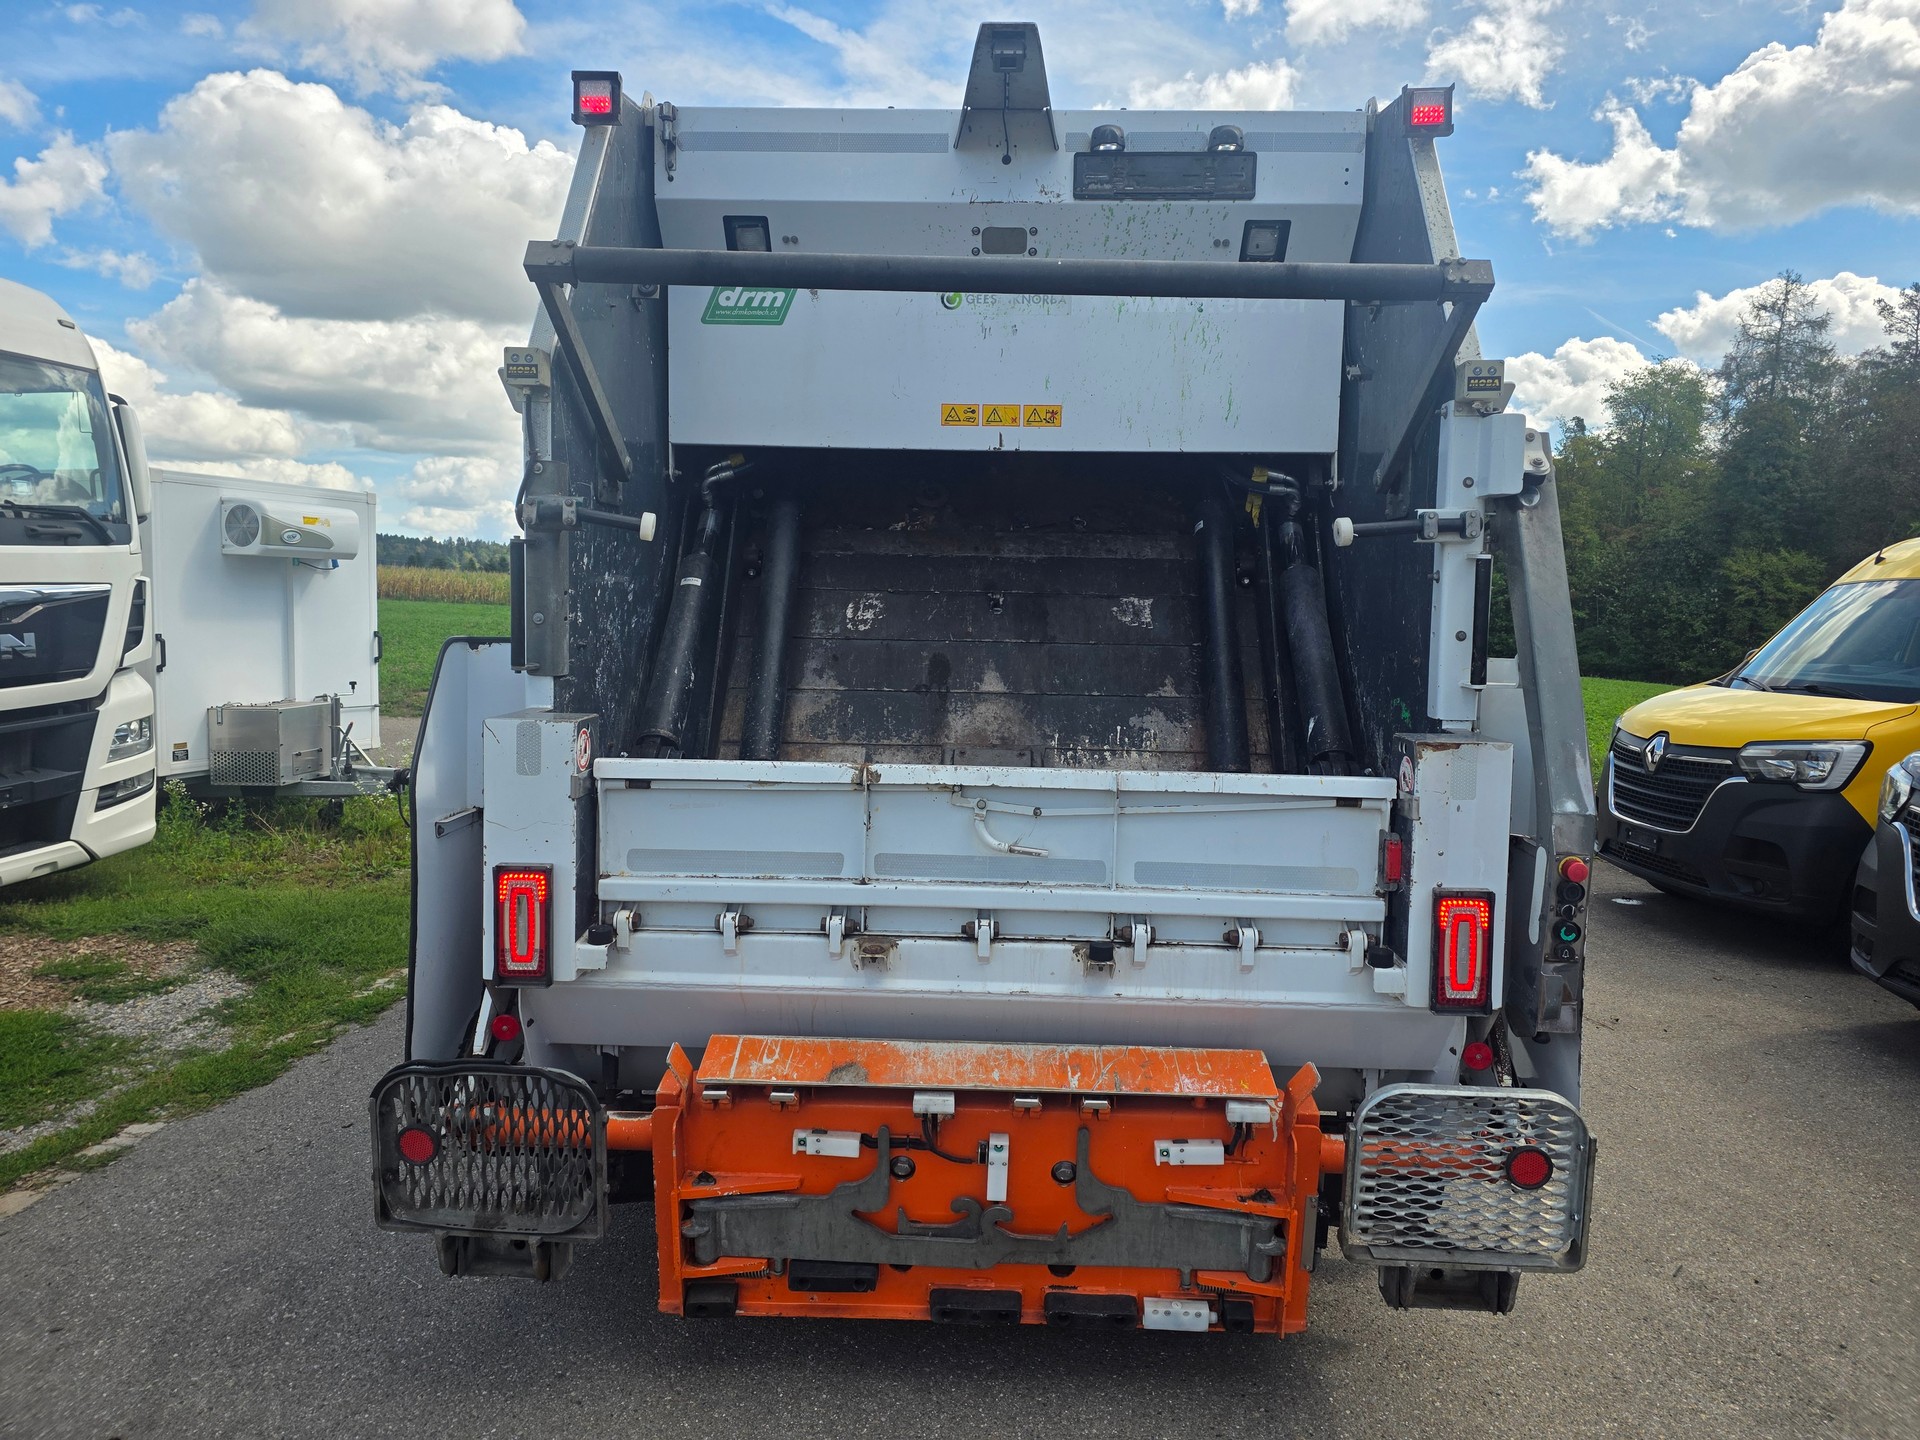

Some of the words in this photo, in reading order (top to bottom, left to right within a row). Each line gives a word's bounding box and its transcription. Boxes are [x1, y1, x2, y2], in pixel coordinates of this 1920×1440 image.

[718, 287, 786, 307] drm
[715, 308, 778, 316] www.drmkomtech.ch
[508, 366, 537, 374] MOBA
[1469, 378, 1500, 387] MOBA
